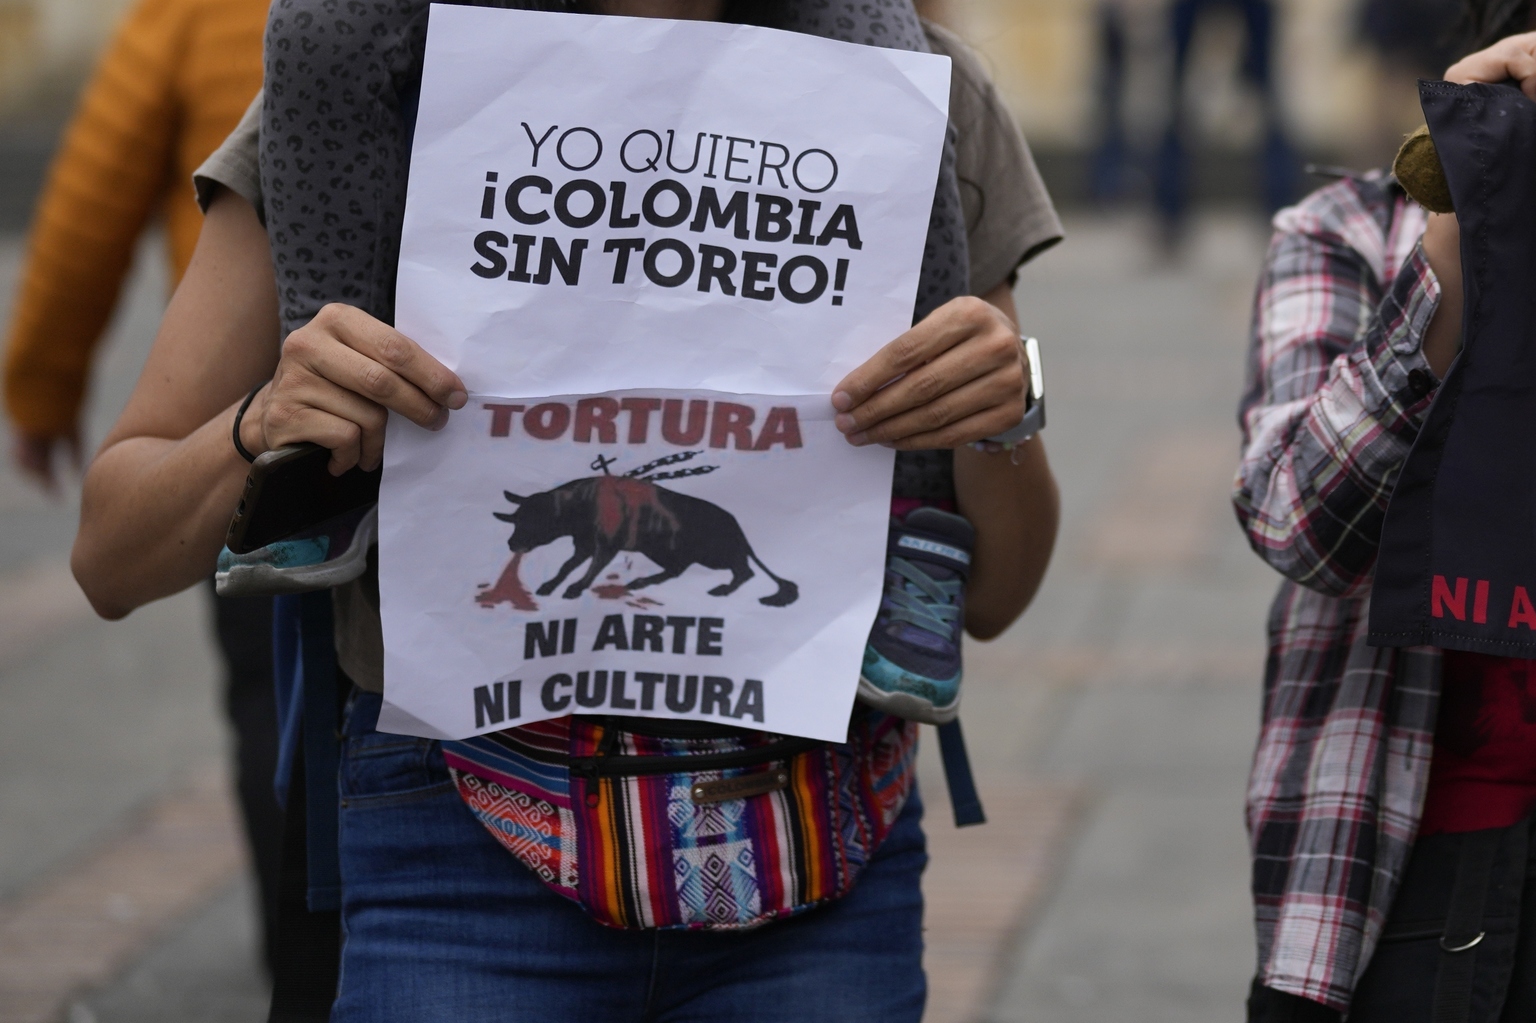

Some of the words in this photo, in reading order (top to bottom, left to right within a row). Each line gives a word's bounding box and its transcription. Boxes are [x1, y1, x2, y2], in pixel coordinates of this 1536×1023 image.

[521, 122, 603, 171] YO
[620, 129, 838, 193] QUIERO
[481, 171, 863, 250] ¡COLOMBIA
[470, 231, 589, 286] SIN
[603, 238, 849, 306] TOREO!
[483, 396, 803, 451] TORTURA
[1431, 575, 1490, 624] NI
[524, 618, 576, 659] NI
[592, 614, 724, 656] ARTE
[474, 679, 523, 728] NI
[541, 671, 765, 723] CULTURA
